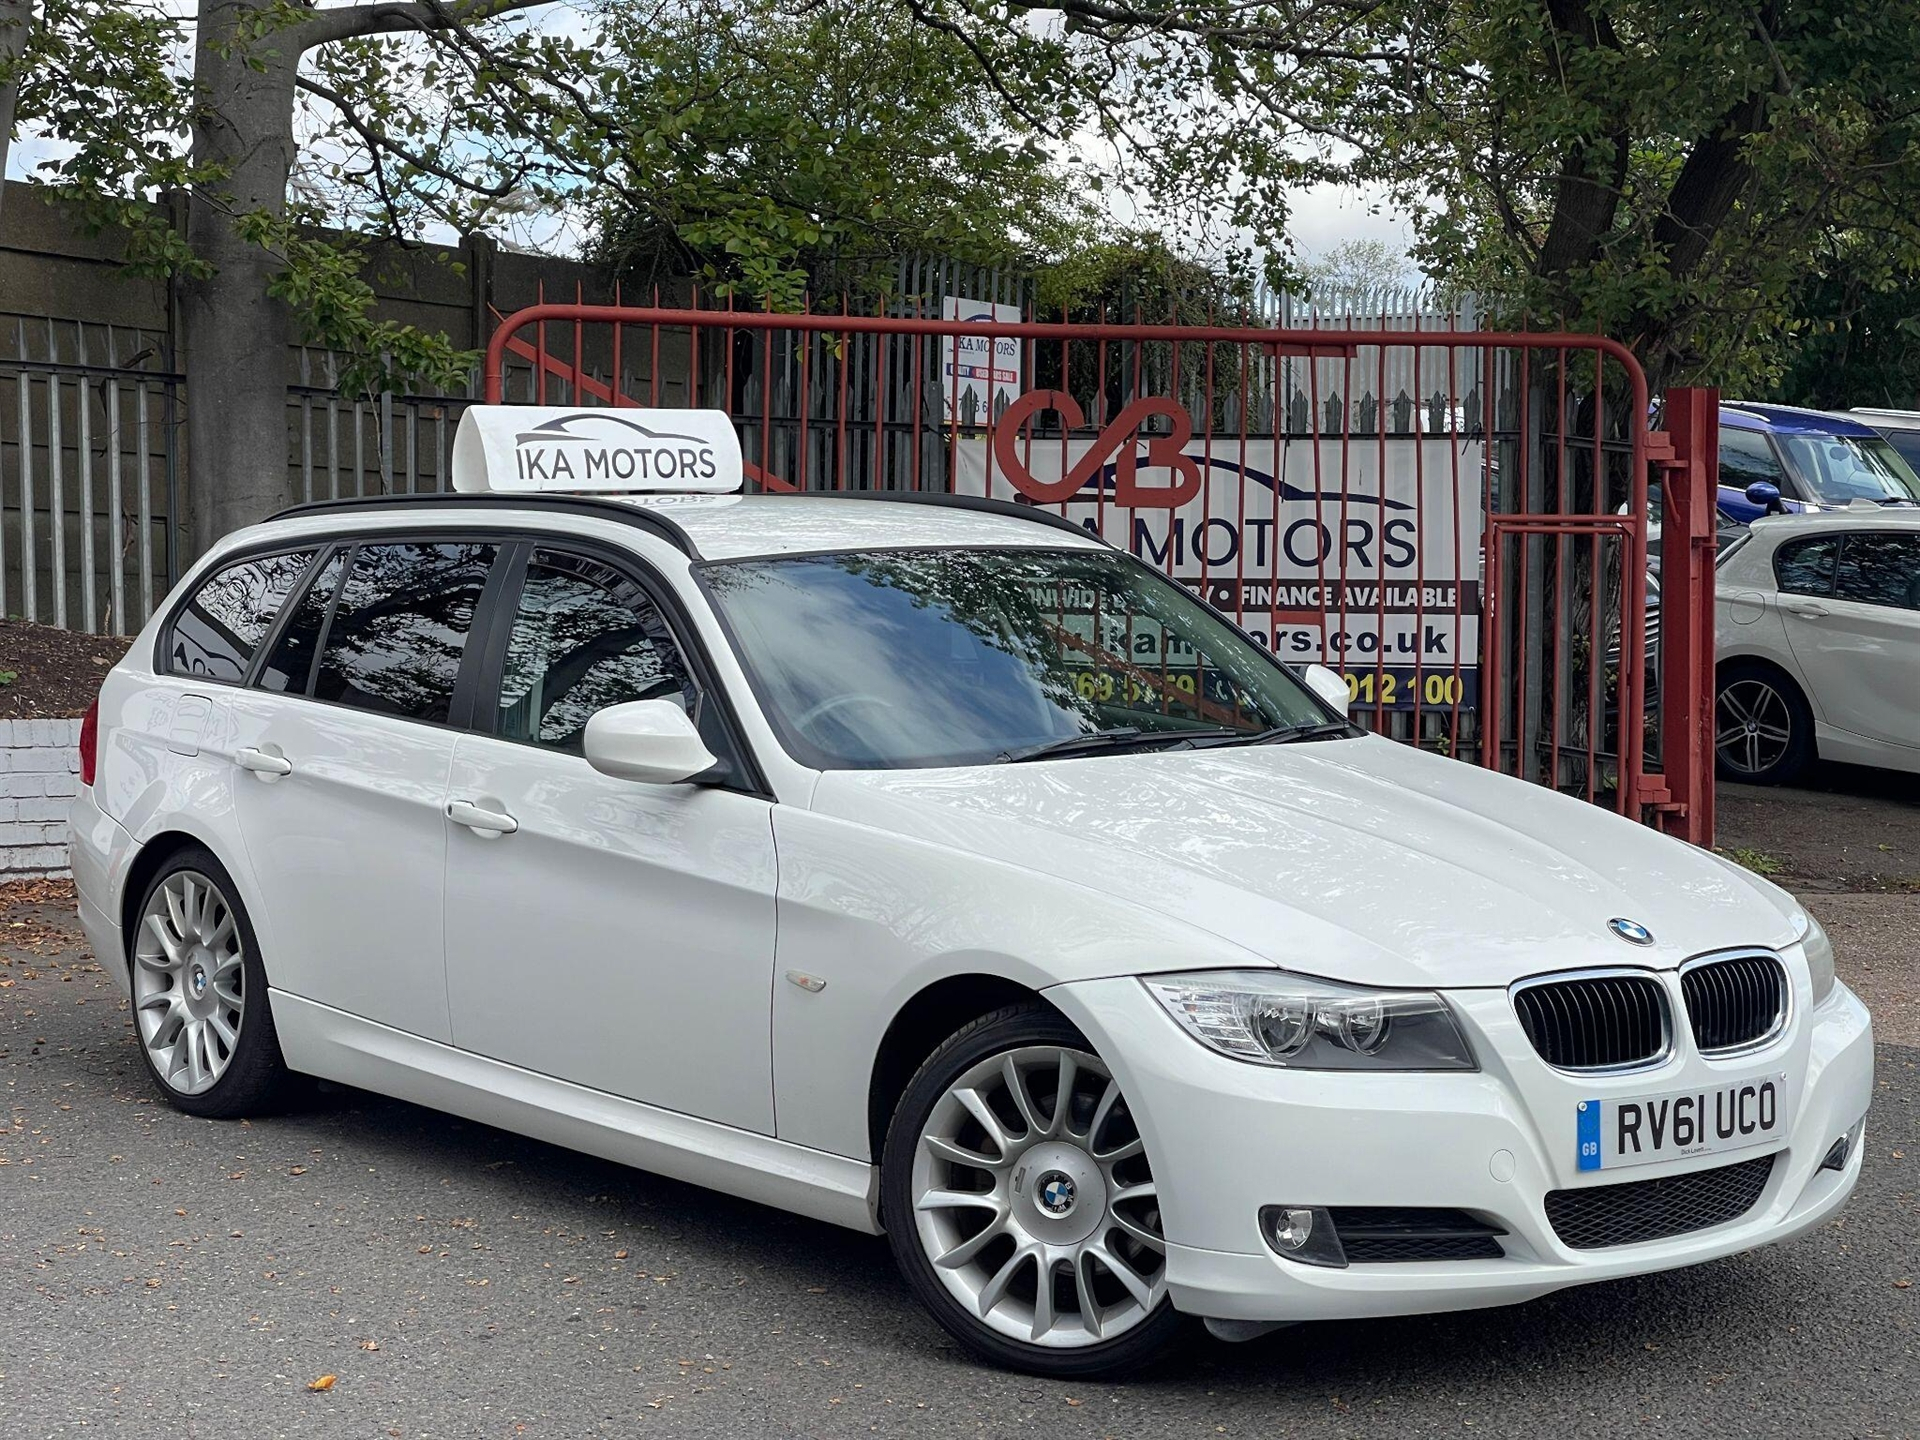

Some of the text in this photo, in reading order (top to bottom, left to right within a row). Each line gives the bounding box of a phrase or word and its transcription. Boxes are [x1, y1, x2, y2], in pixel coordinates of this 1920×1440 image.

[975, 339, 1017, 356] MOORS
[515, 448, 717, 480] IKA MOTORS
[1134, 517, 1417, 568] MOTORS
[1241, 586, 1333, 607] FINANCE
[1338, 587, 1457, 608] AVAILABLE
[1618, 1081, 1776, 1155] RV61 UCO
[1582, 1141, 1598, 1157] GB
